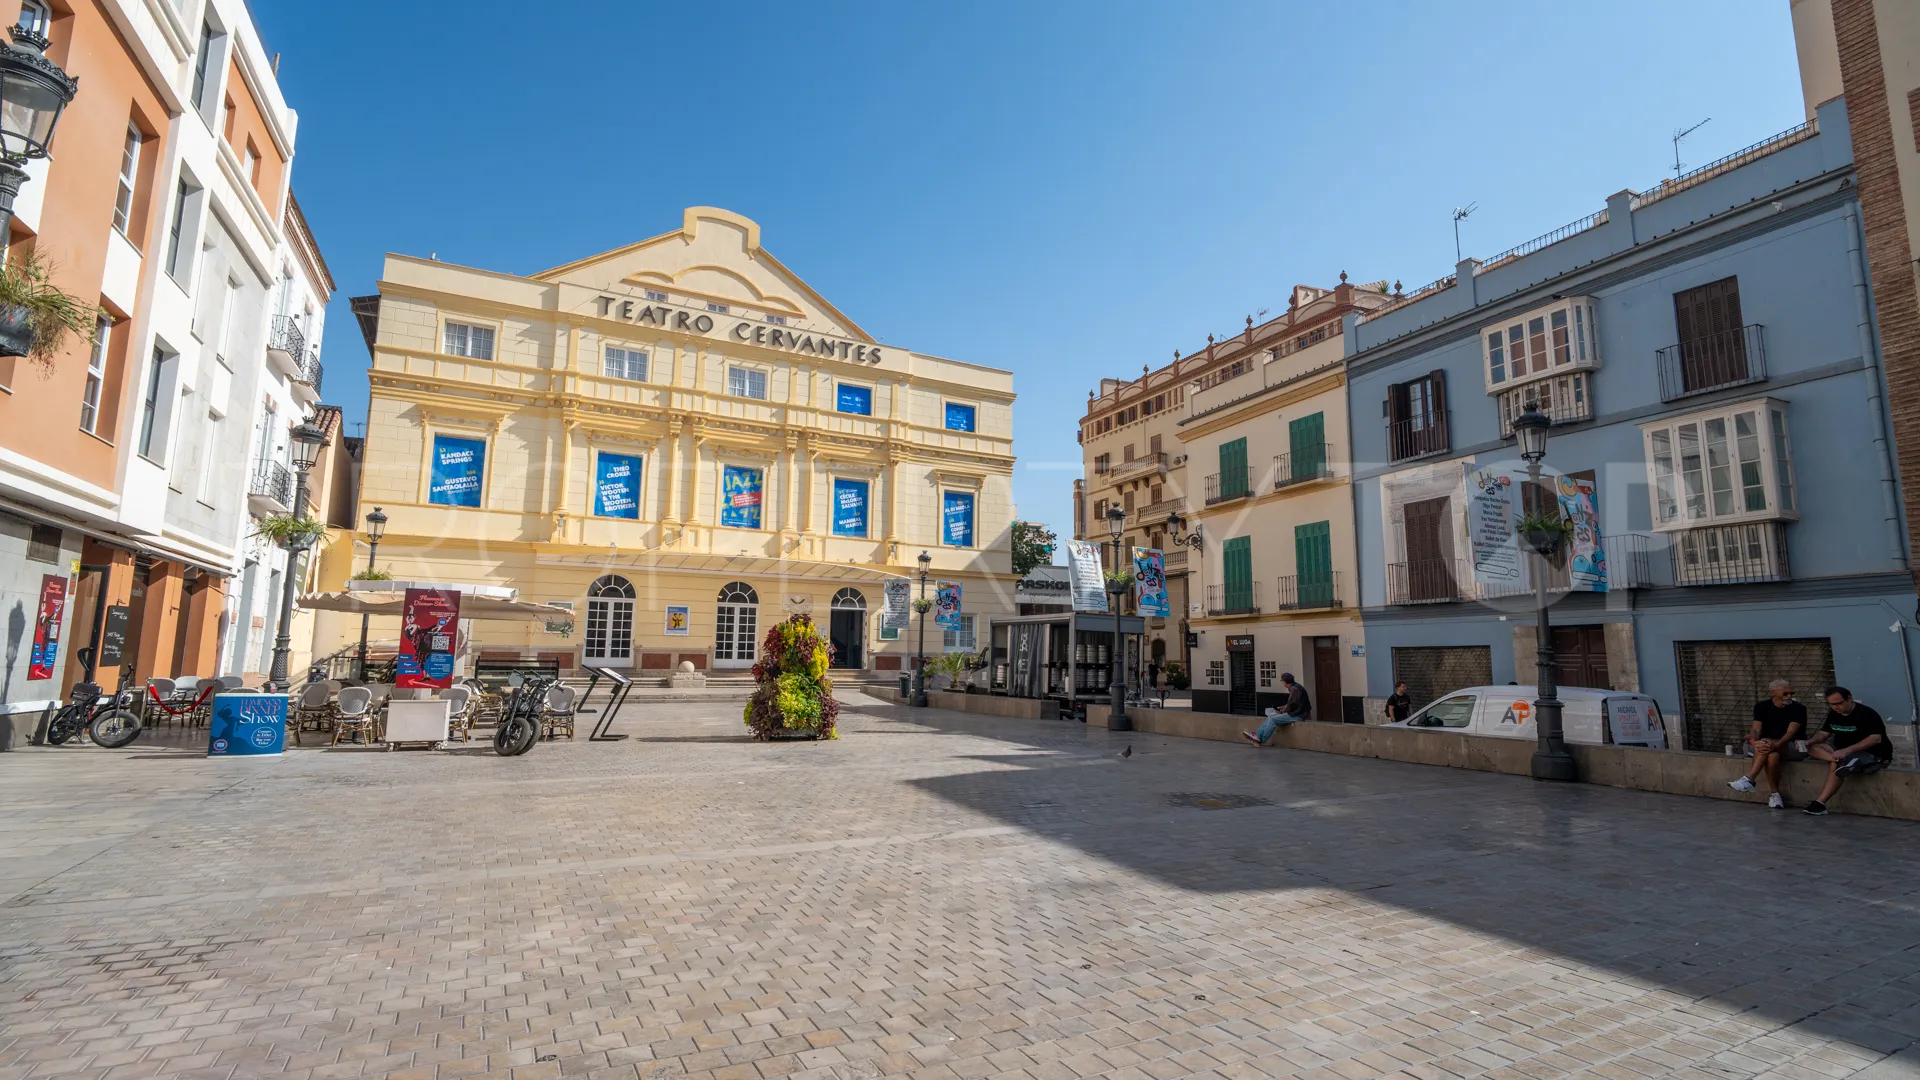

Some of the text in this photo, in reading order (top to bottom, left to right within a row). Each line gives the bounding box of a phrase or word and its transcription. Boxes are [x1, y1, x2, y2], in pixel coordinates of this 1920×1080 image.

[597, 295, 882, 364] TEATRO CERVANTES
[440, 450, 474, 459] KANDACE
[441, 456, 473, 465] SPRINGS
[606, 471, 631, 479] CROKER
[444, 476, 477, 485] GUSTAVO
[432, 481, 479, 493] SANTAOLALLA
[600, 483, 624, 491] VICTOR
[601, 487, 629, 496] WOOTEN
[603, 498, 631, 507] WOOTEN
[604, 502, 636, 512] BROTHERS
[418, 594, 446, 602] Flamenco
[434, 600, 450, 608] Show
[239, 711, 280, 724] Show
